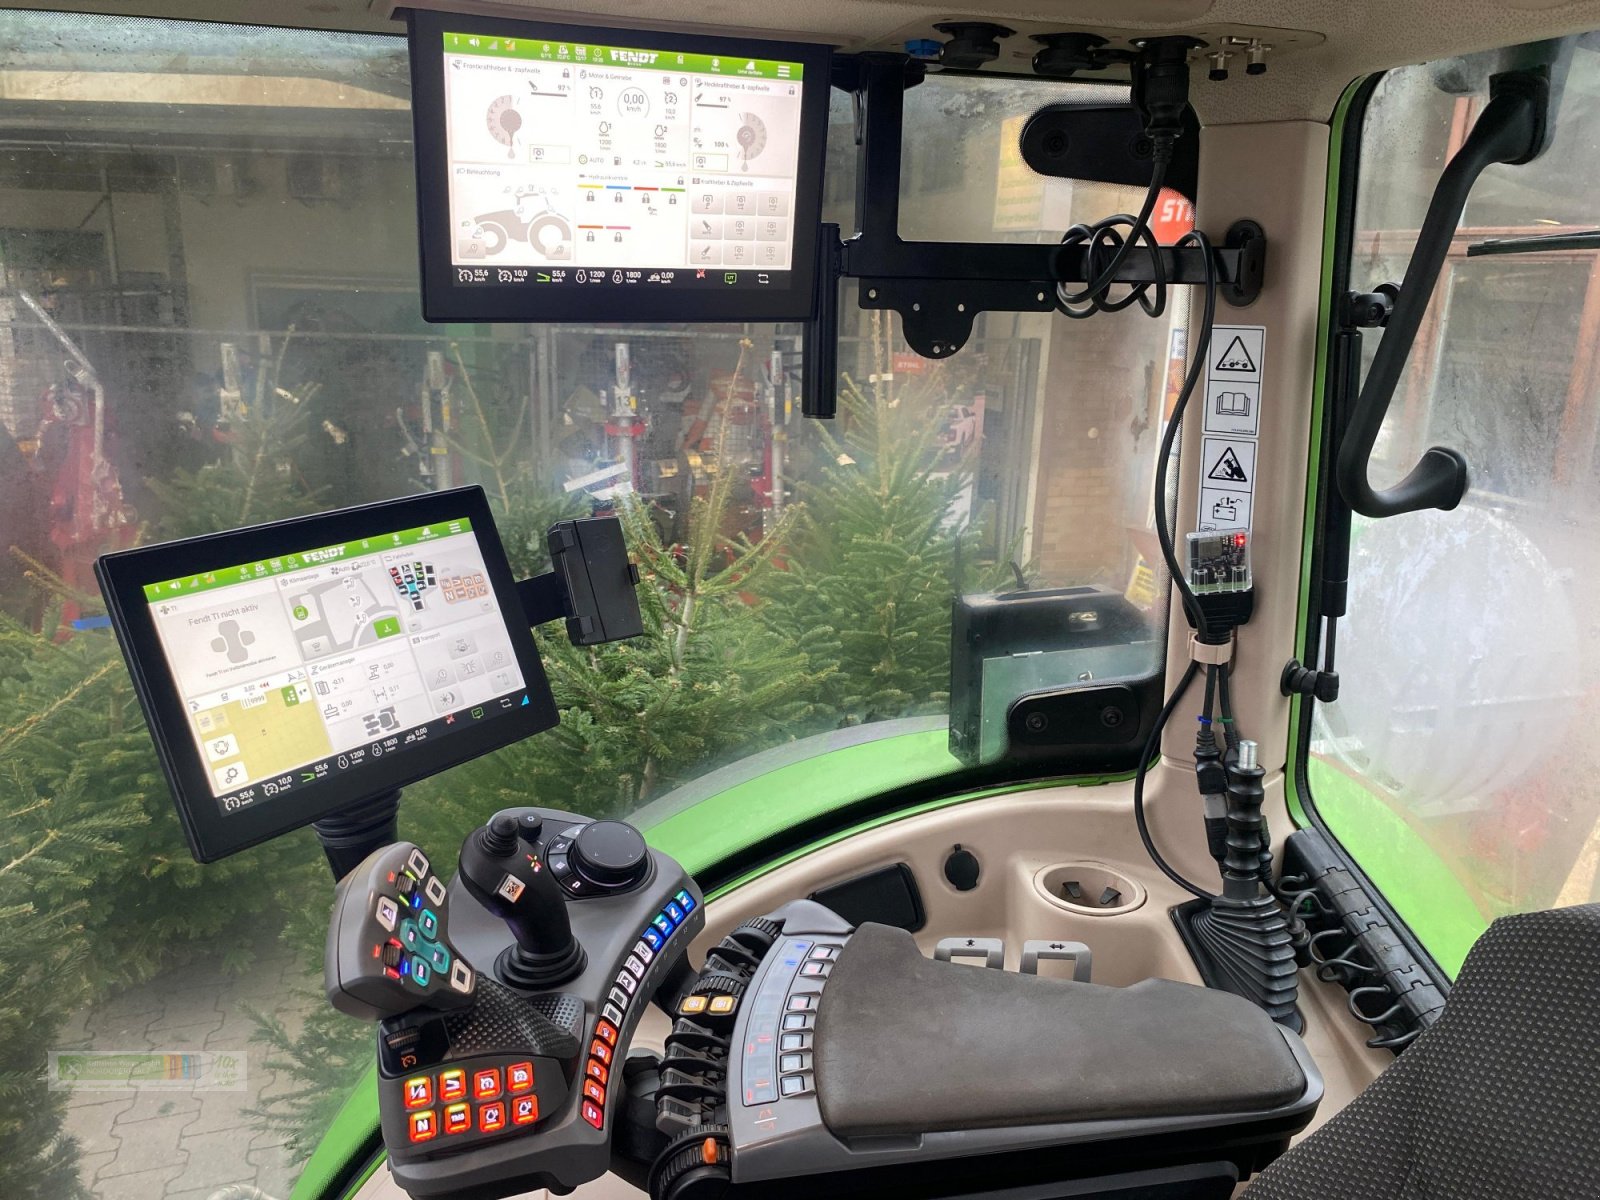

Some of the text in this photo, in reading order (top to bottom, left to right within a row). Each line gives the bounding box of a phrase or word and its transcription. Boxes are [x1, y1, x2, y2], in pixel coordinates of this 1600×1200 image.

[609, 49, 659, 64] FENDT
[623, 94, 644, 105] 0,00
[552, 270, 566, 278] 55,6
[625, 271, 642, 279] 1800
[302, 545, 347, 564] FENDT
[188, 612, 212, 626] Fendt
[220, 607, 240, 619] nicht
[241, 603, 259, 614] aktiv
[383, 737, 398, 748] 1800
[349, 749, 365, 760] 1200
[314, 762, 329, 773] 55,6
[278, 775, 293, 786] 10,0
[239, 789, 255, 800] 55,6
[416, 1119, 429, 1132] N
